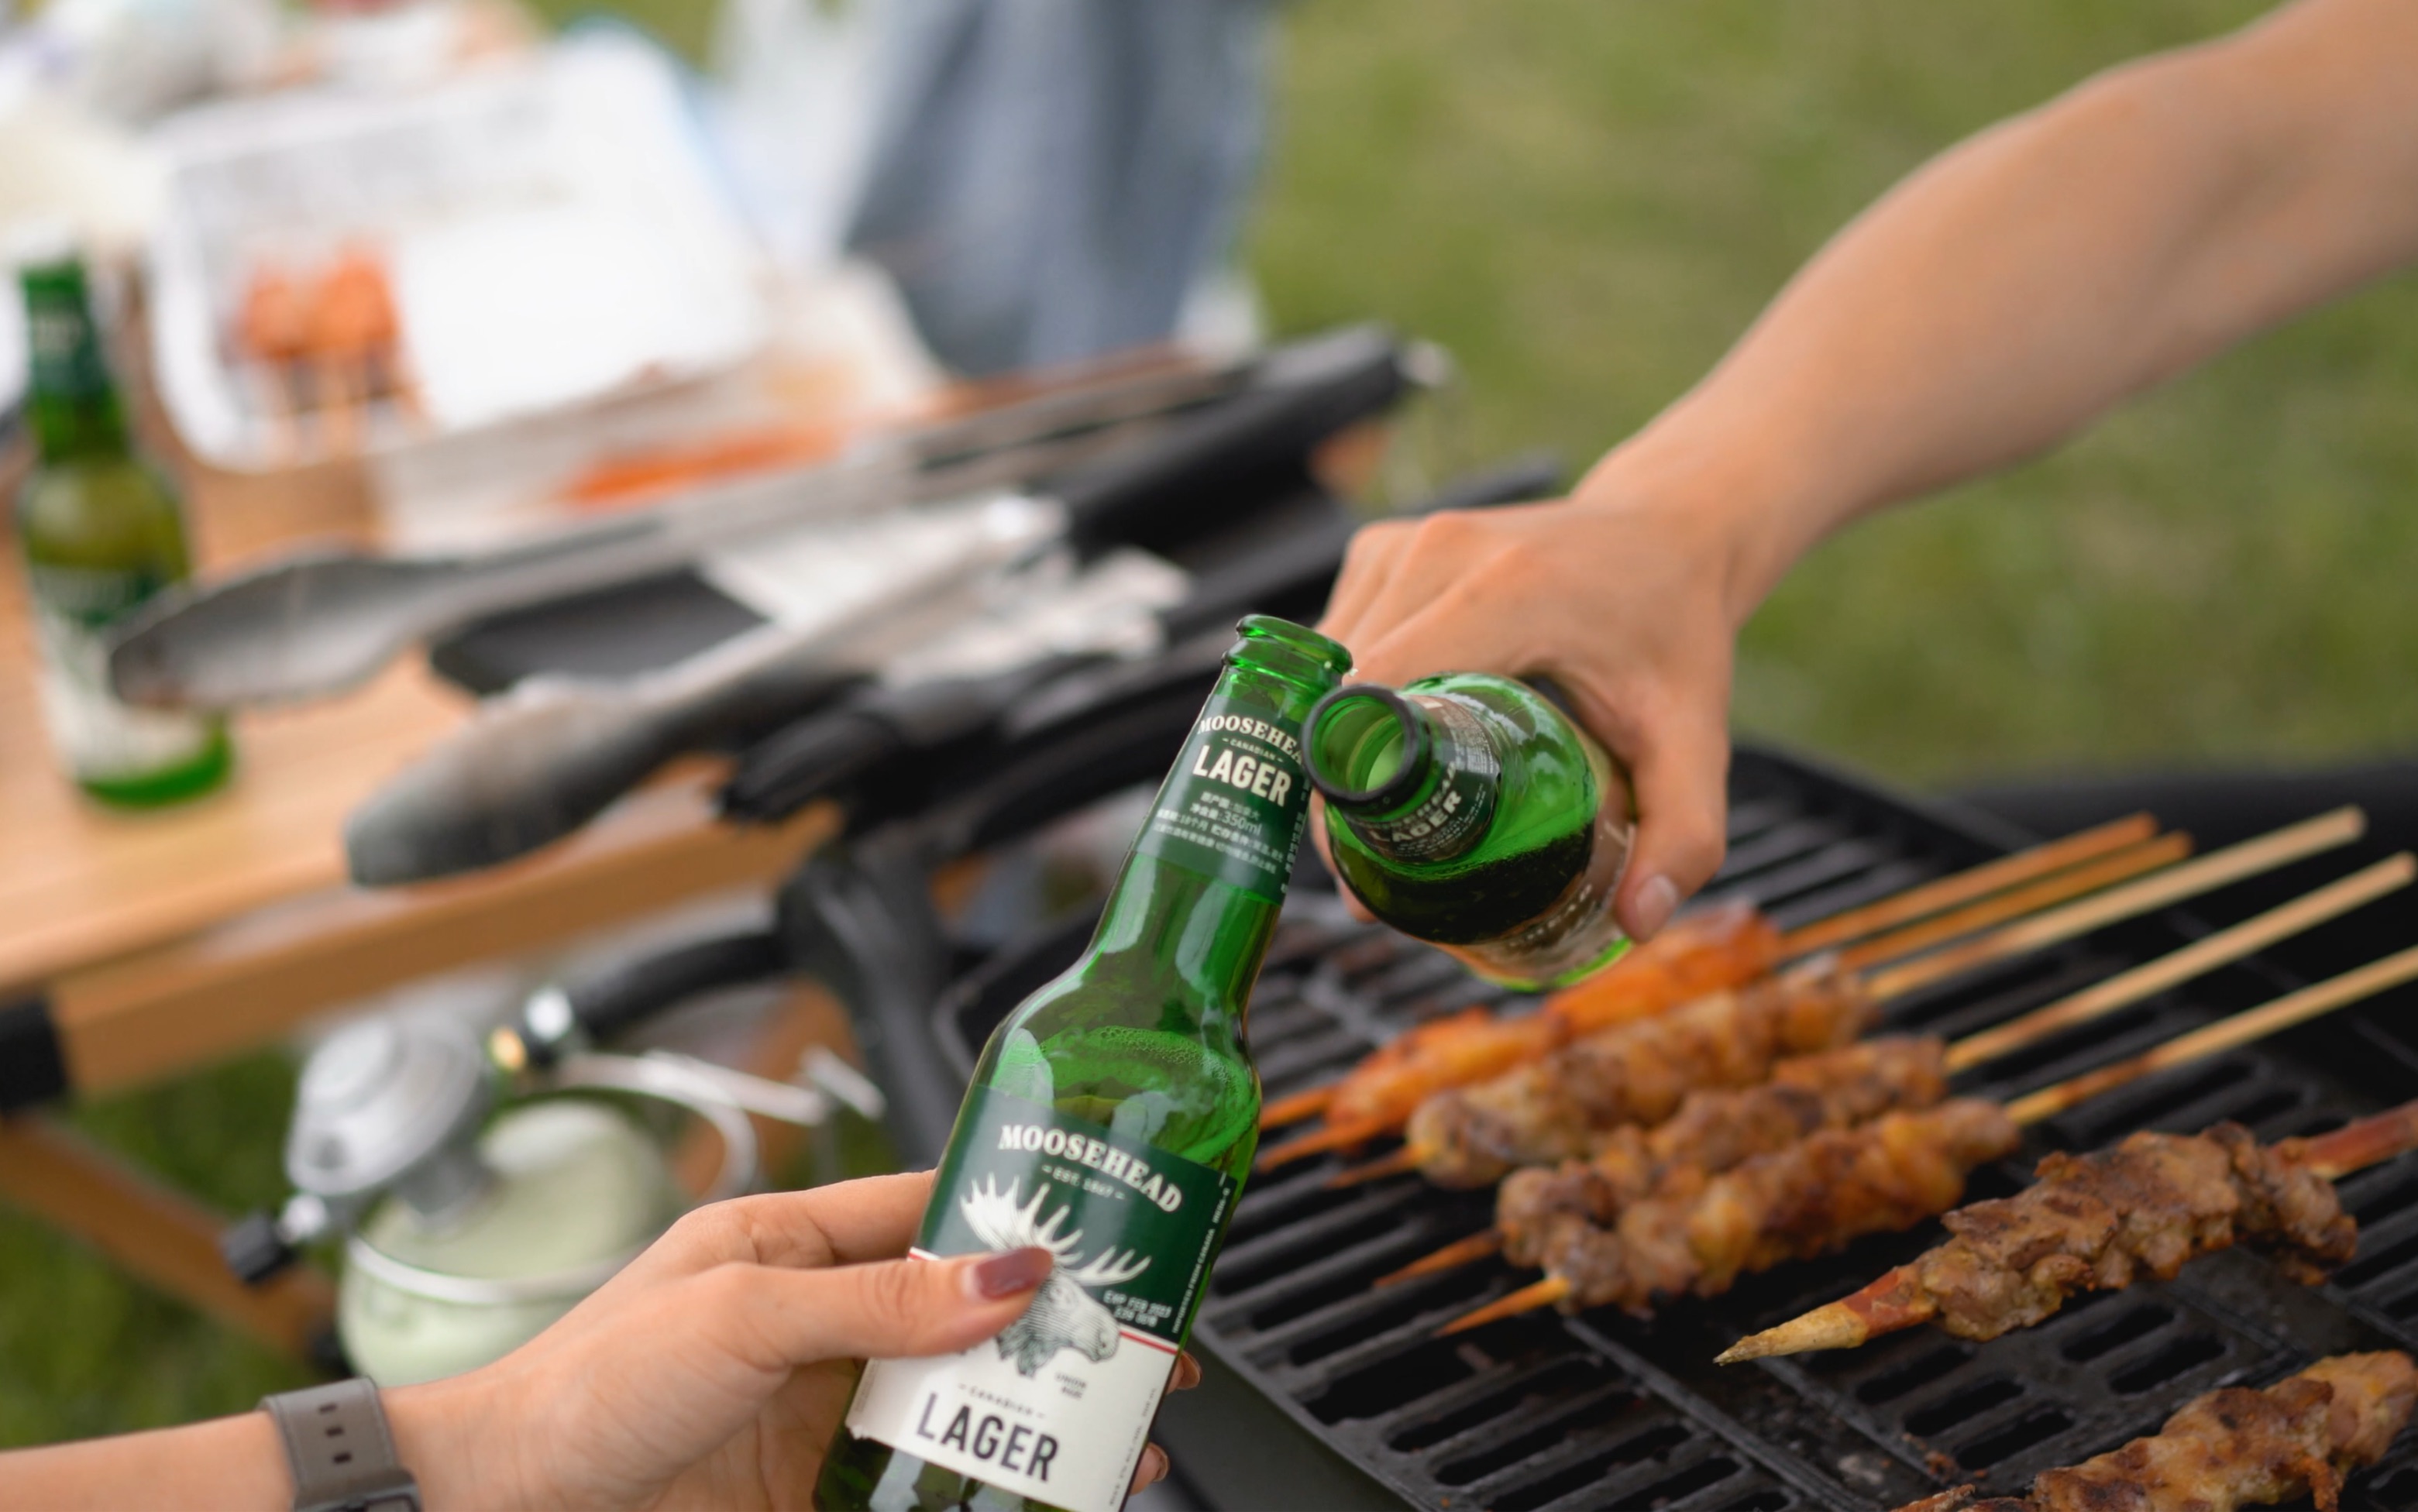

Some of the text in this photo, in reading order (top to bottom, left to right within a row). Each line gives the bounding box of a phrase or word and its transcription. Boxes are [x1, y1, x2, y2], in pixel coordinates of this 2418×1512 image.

[1197, 715, 1304, 765] MOOSEHEA
[1230, 737, 1276, 761] CANADIAN
[1192, 744, 1292, 807] LAGER
[997, 1124, 1182, 1213] MOOSEHEAD
[917, 1391, 1059, 1482] LAGER
